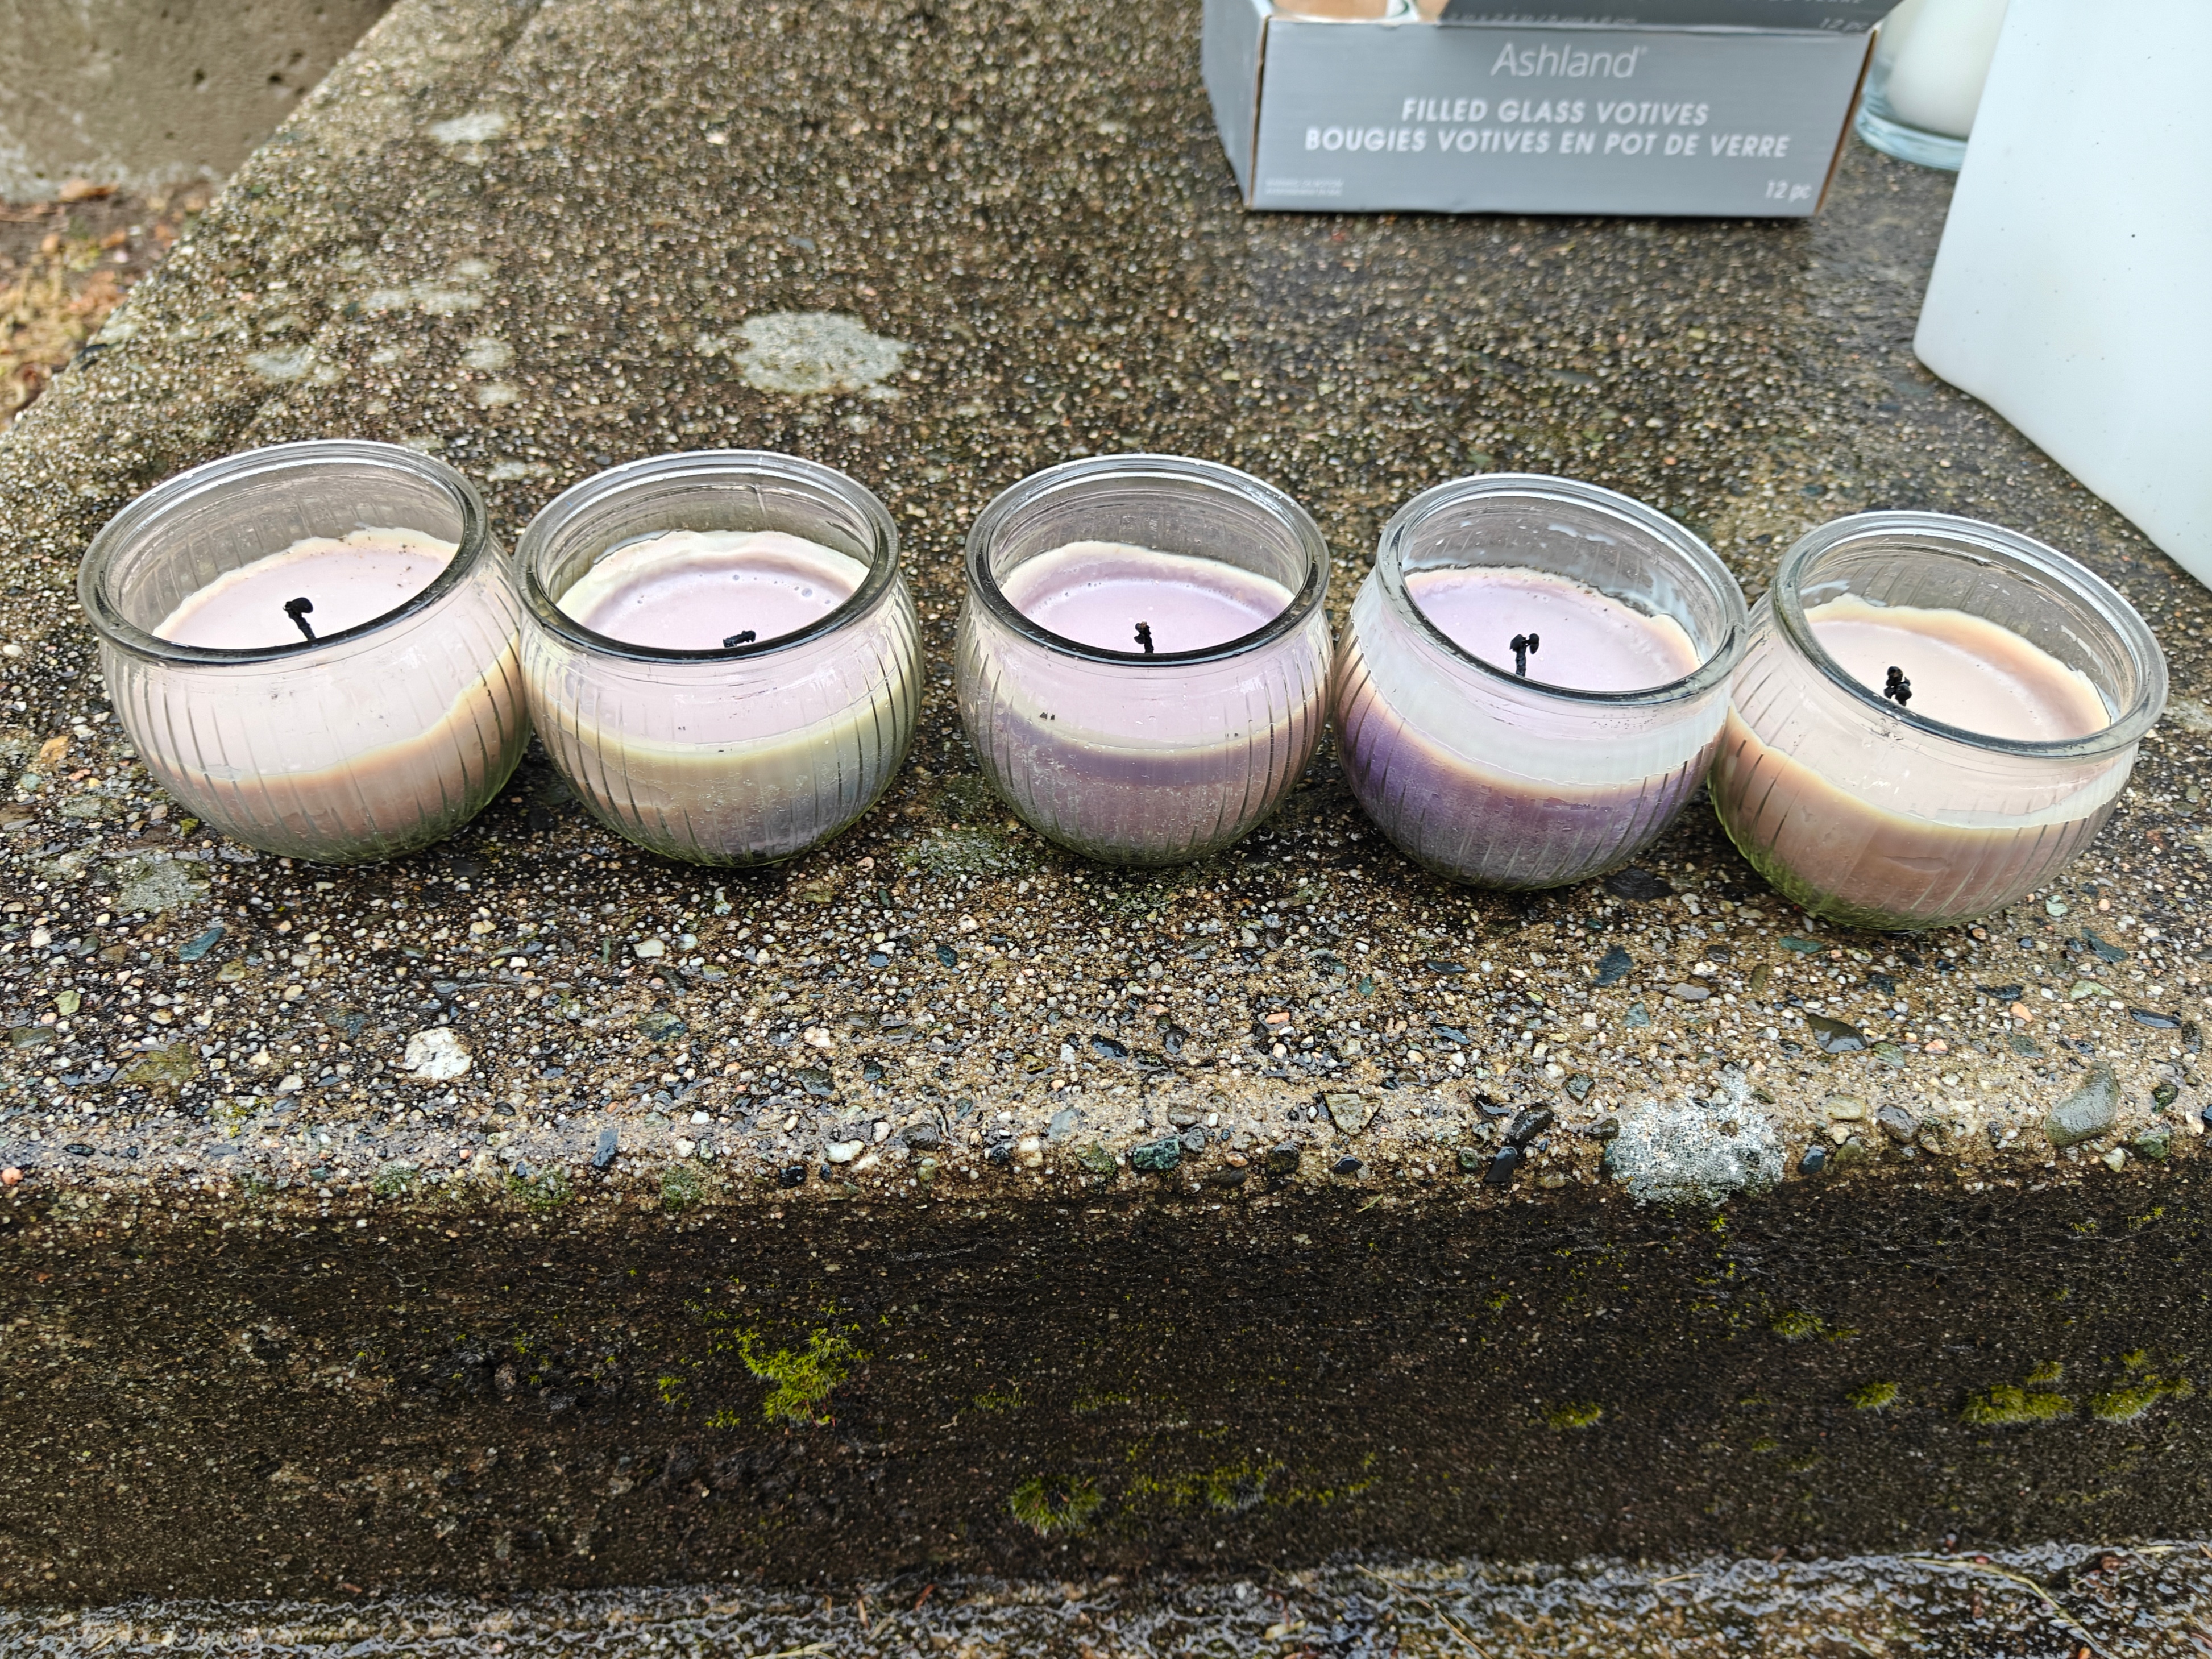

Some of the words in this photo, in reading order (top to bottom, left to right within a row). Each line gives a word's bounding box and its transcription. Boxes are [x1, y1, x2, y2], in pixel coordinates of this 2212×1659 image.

[1819, 17, 1845, 30] 12
[1401, 96, 1489, 122] FILLED
[1497, 98, 1586, 124] GLASS
[1596, 100, 1710, 127] VOTIVES
[1305, 126, 1428, 152] BOUGIES
[1437, 128, 1551, 154] VOTIVES
[1559, 130, 1596, 155] EN
[1603, 131, 1658, 156] POT
[1663, 133, 1700, 156] DE
[1710, 134, 1790, 158] VERRE
[1765, 180, 1789, 200] 12
[1788, 183, 1813, 204] pc
